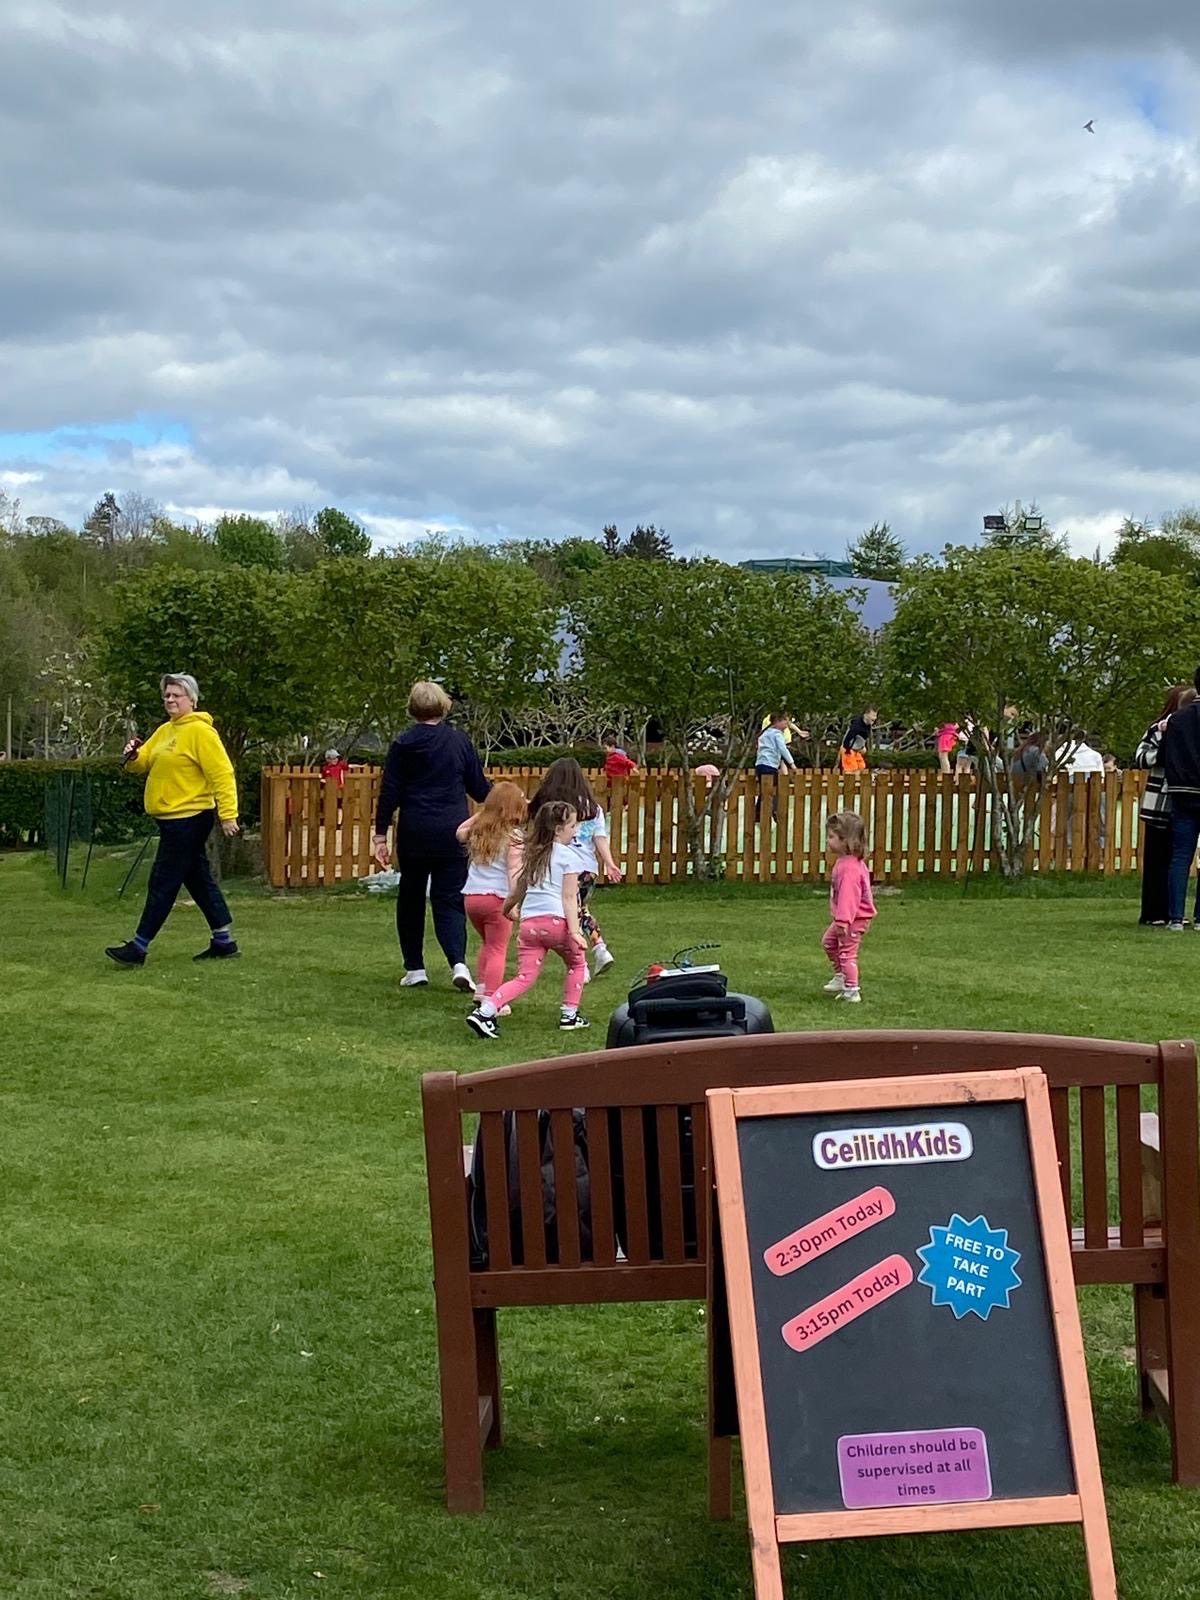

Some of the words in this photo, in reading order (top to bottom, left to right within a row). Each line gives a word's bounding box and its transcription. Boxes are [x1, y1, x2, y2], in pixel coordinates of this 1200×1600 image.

[820, 1129, 962, 1164] CeilidhKids
[776, 1225, 837, 1267] 2:30pm
[836, 1198, 884, 1232] Today
[944, 1233, 980, 1255] FREE
[984, 1244, 1004, 1261] TO
[953, 1256, 989, 1278] TAKE
[946, 1276, 986, 1298] PART
[796, 1300, 854, 1341] 3:15pm
[852, 1268, 900, 1302] Today
[847, 1442, 906, 1458] Children
[909, 1439, 956, 1454] should
[959, 1438, 977, 1451] be
[857, 1462, 933, 1479] supervised
[937, 1462, 950, 1473] at
[954, 1459, 971, 1472] all
[897, 1482, 936, 1496] times
